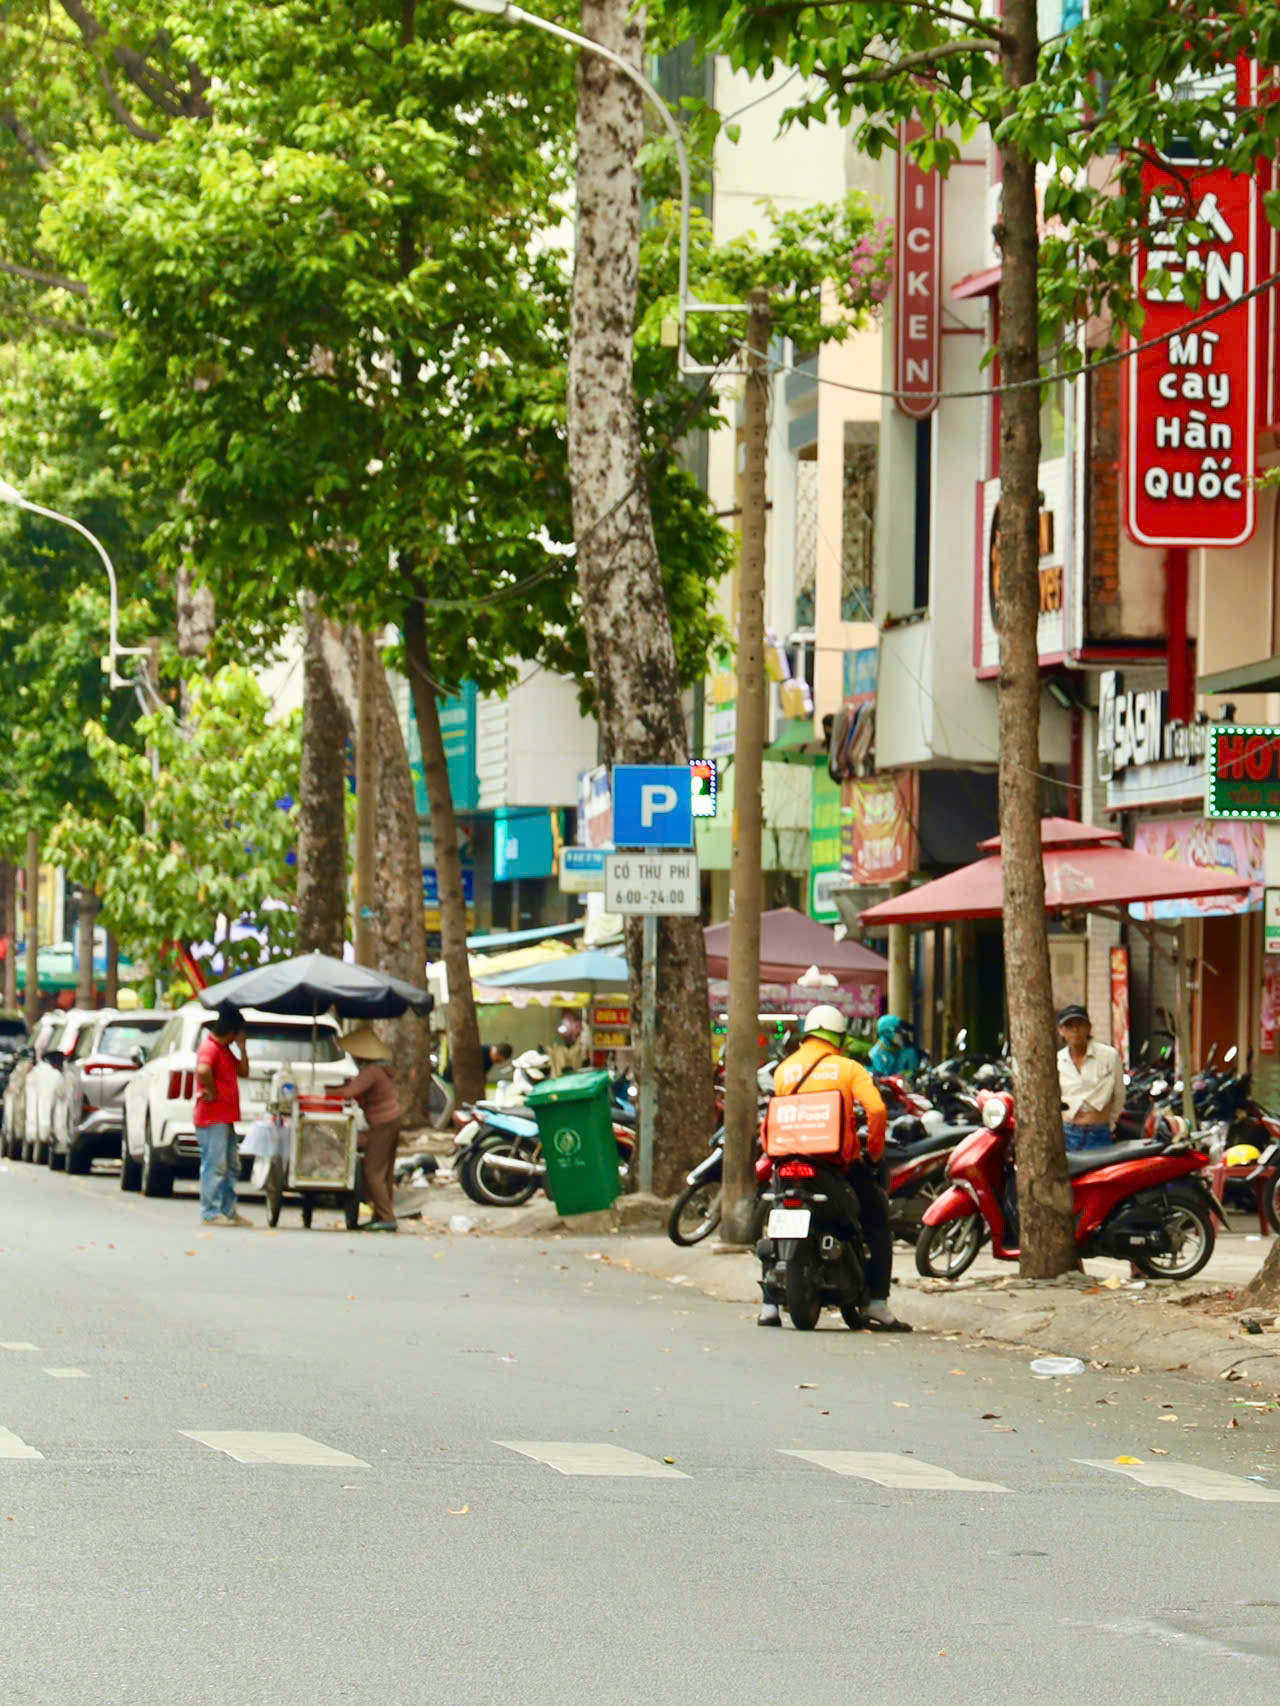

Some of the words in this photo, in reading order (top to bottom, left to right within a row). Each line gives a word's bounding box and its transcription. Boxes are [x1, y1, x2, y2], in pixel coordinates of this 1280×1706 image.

[1168, 330, 1220, 367] Mì
[1159, 371, 1231, 408] cay
[1155, 409, 1232, 450] Hàn
[1144, 456, 1243, 500] Quốc
[641, 784, 678, 828] P
[613, 861, 631, 879] CÓ
[638, 864, 662, 879] THU
[669, 861, 691, 879] PHÍ
